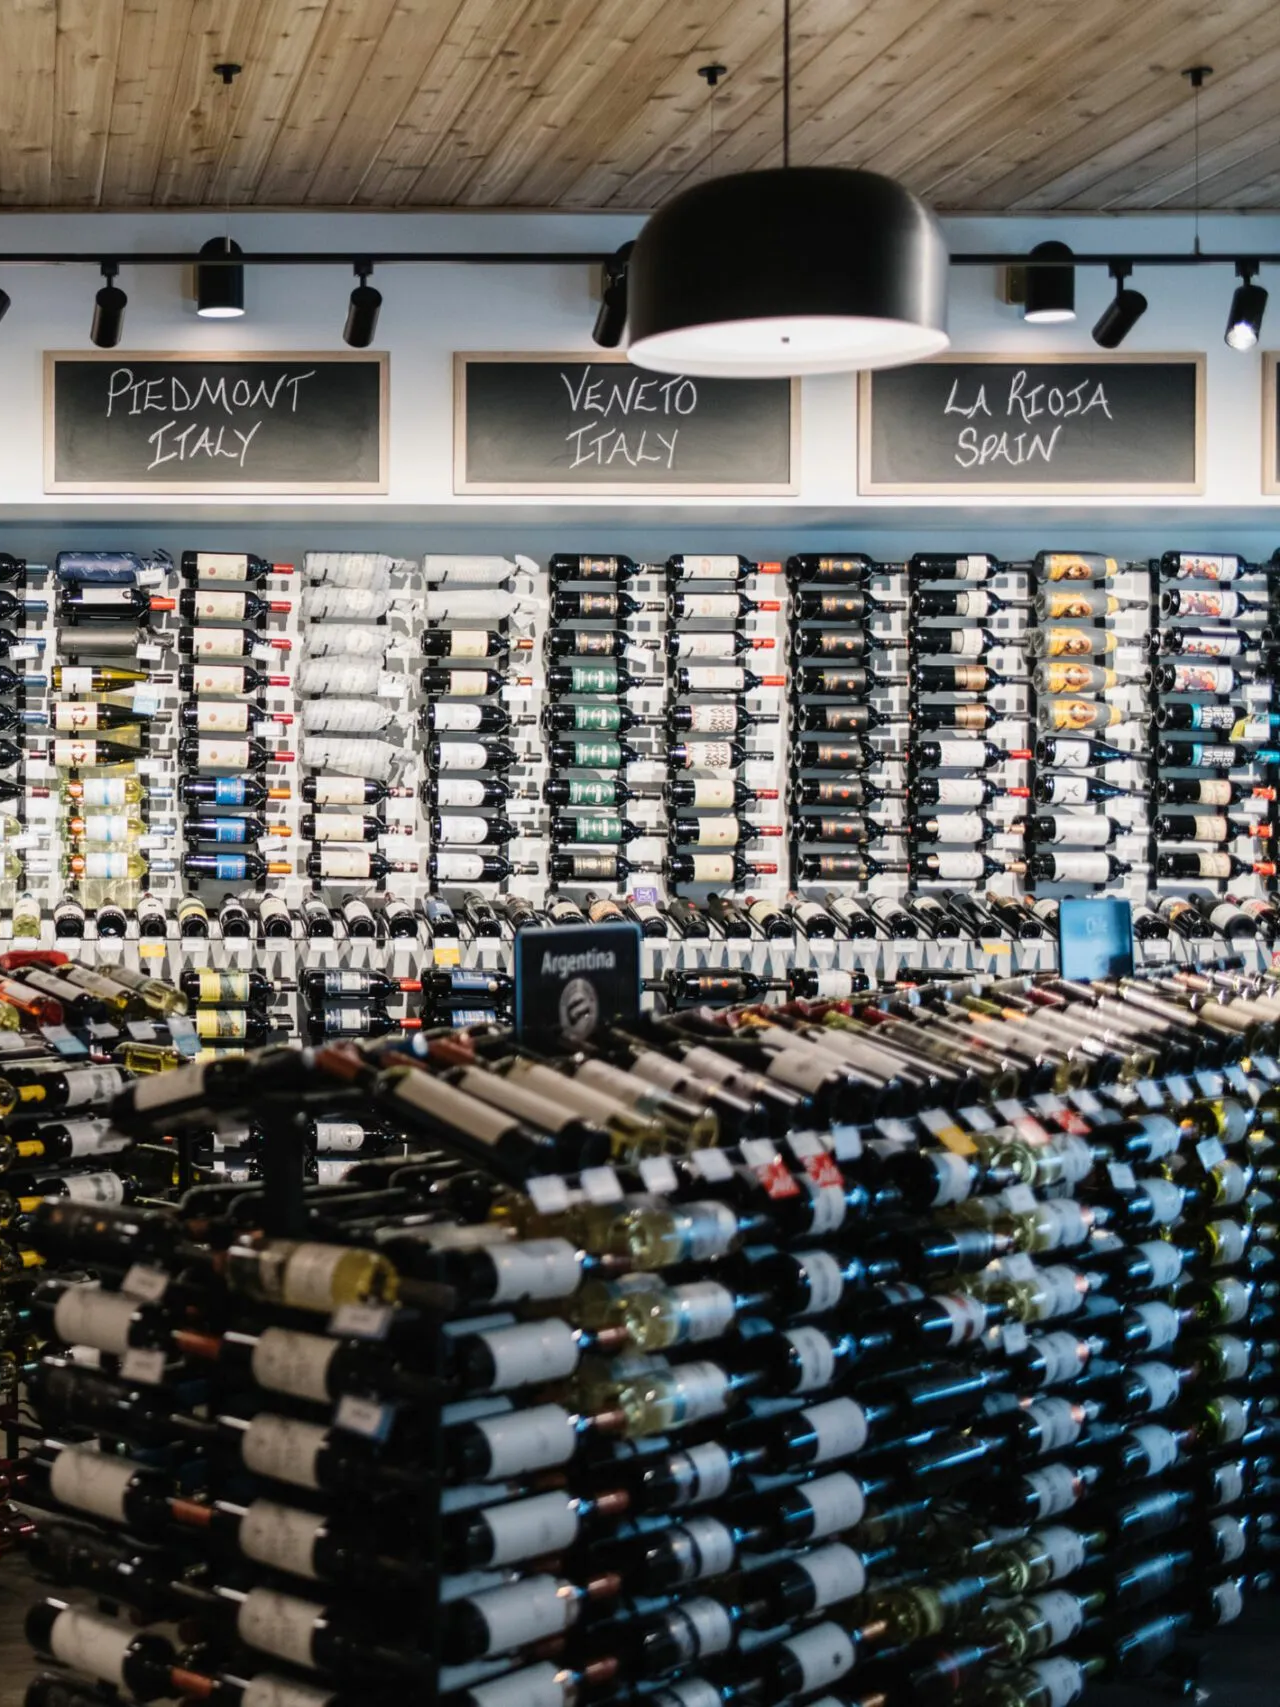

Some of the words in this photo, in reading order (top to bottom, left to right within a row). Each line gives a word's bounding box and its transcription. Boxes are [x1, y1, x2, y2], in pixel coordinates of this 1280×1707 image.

[107, 368, 316, 418] PIEDMONT
[561, 374, 698, 416] VENETO
[944, 379, 992, 419] LA
[1006, 370, 1113, 424] RIOJA
[148, 420, 262, 470] ITALY
[566, 422, 678, 469] ITALY
[954, 425, 1062, 467] SPAIN
[1221, 707, 1234, 729] BESO
[541, 949, 616, 980] Argentina
